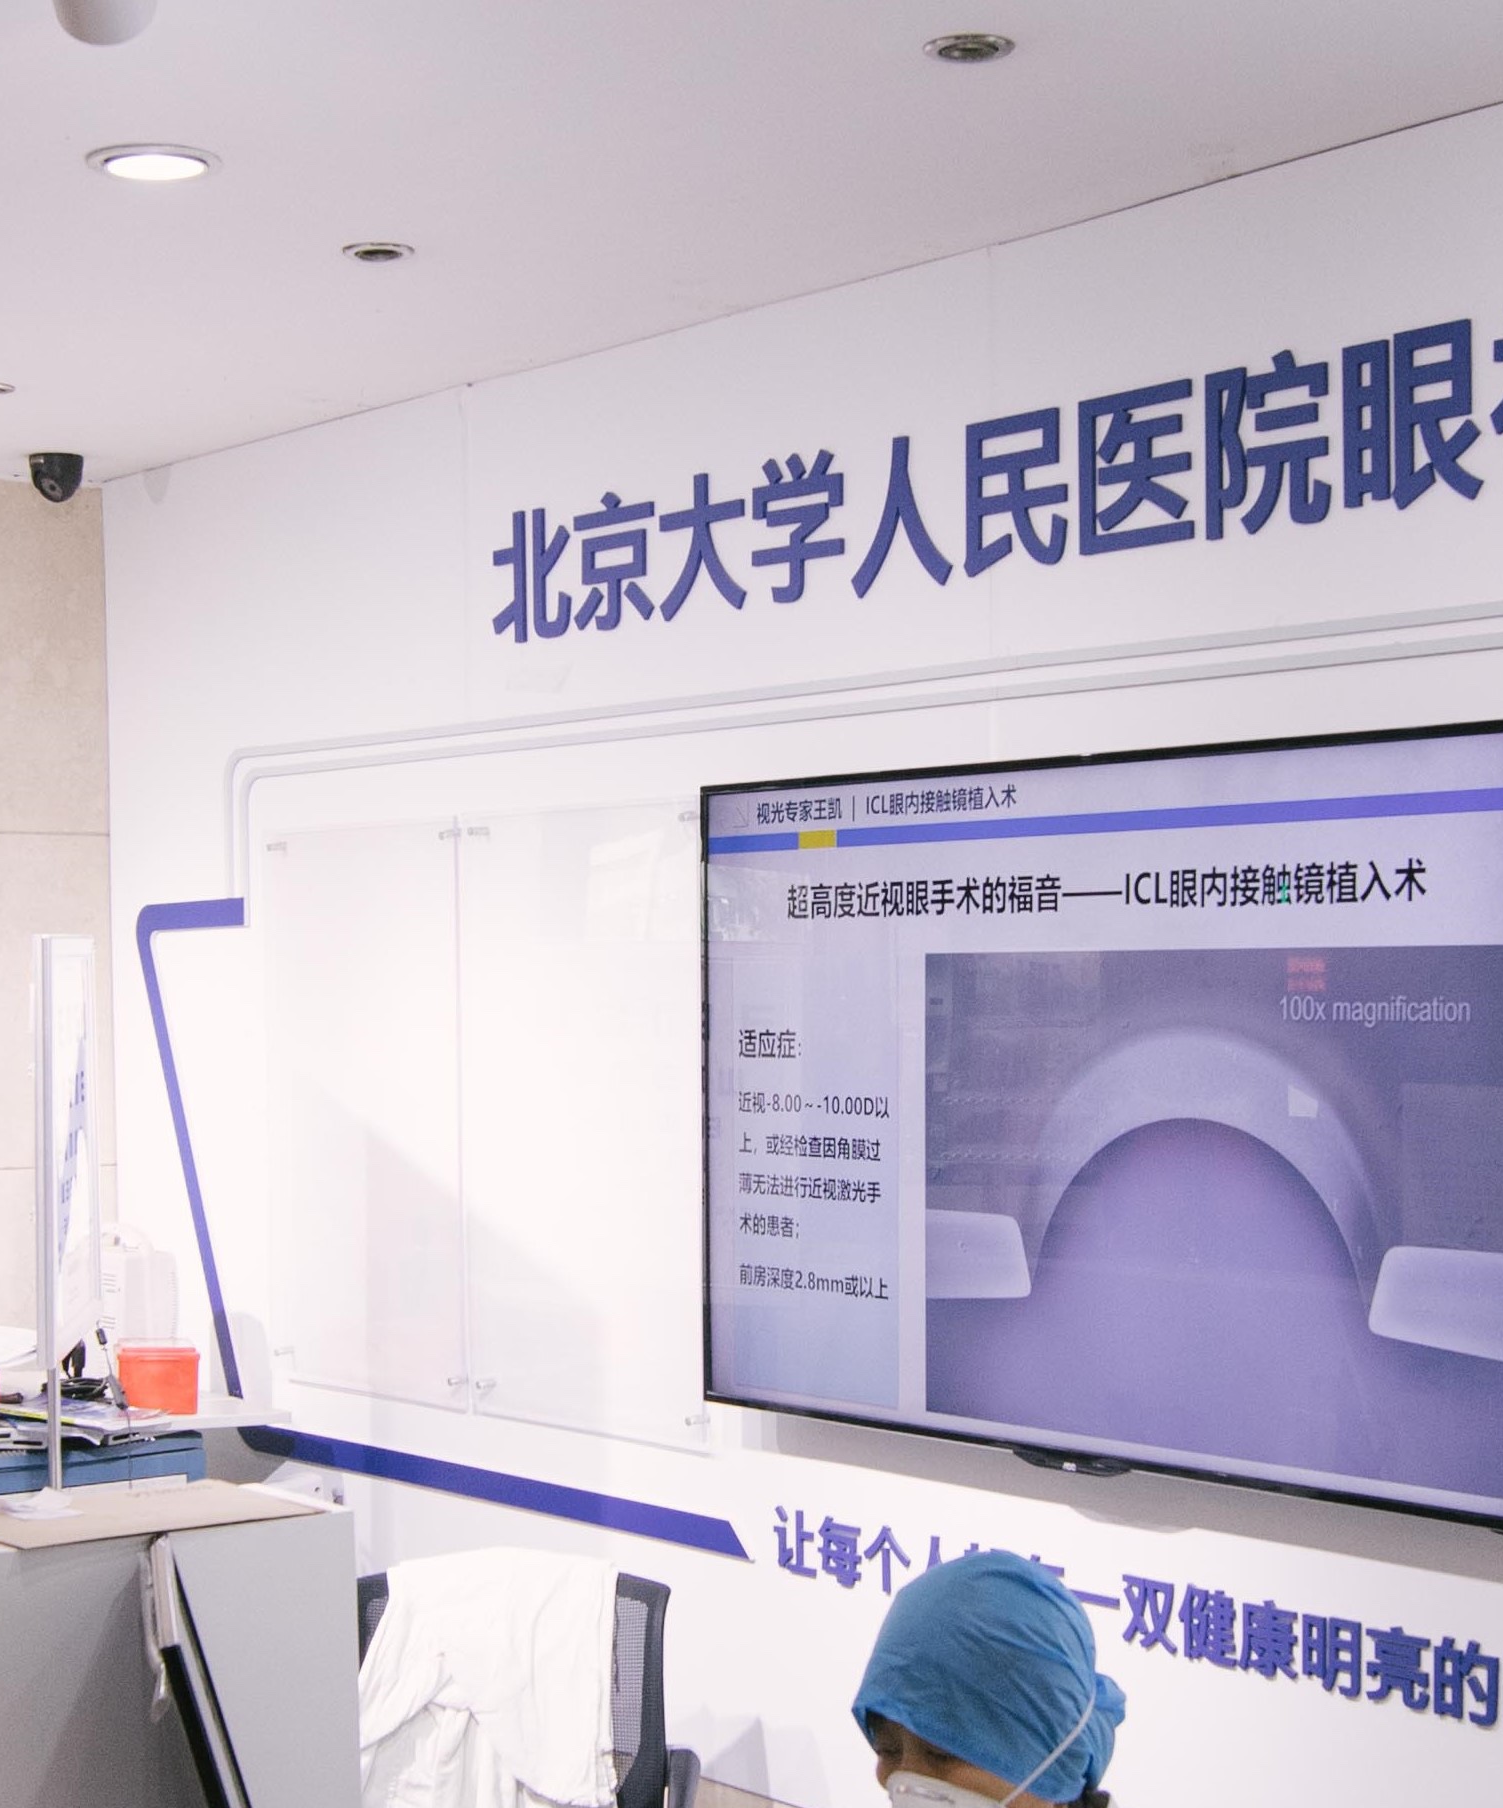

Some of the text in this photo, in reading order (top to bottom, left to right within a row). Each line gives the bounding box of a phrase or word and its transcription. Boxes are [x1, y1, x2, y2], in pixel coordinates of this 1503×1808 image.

[756, 784, 1018, 825] 视光专家王凯 ICL眼内接触镜植入术
[786, 858, 1428, 922] 超高度近视眼手术的福音——ICL眼内接触镜植入术
[1279, 994, 1471, 1029] 100x magnification
[738, 1029, 802, 1059] 适应症：
[739, 1131, 882, 1162] 上，或经检查因角膜过
[738, 1172, 882, 1204] 薄无法进行近视激光手
[739, 1212, 801, 1240] 术的患者；
[739, 1263, 890, 1301] 前房深度2.8mm或以上
